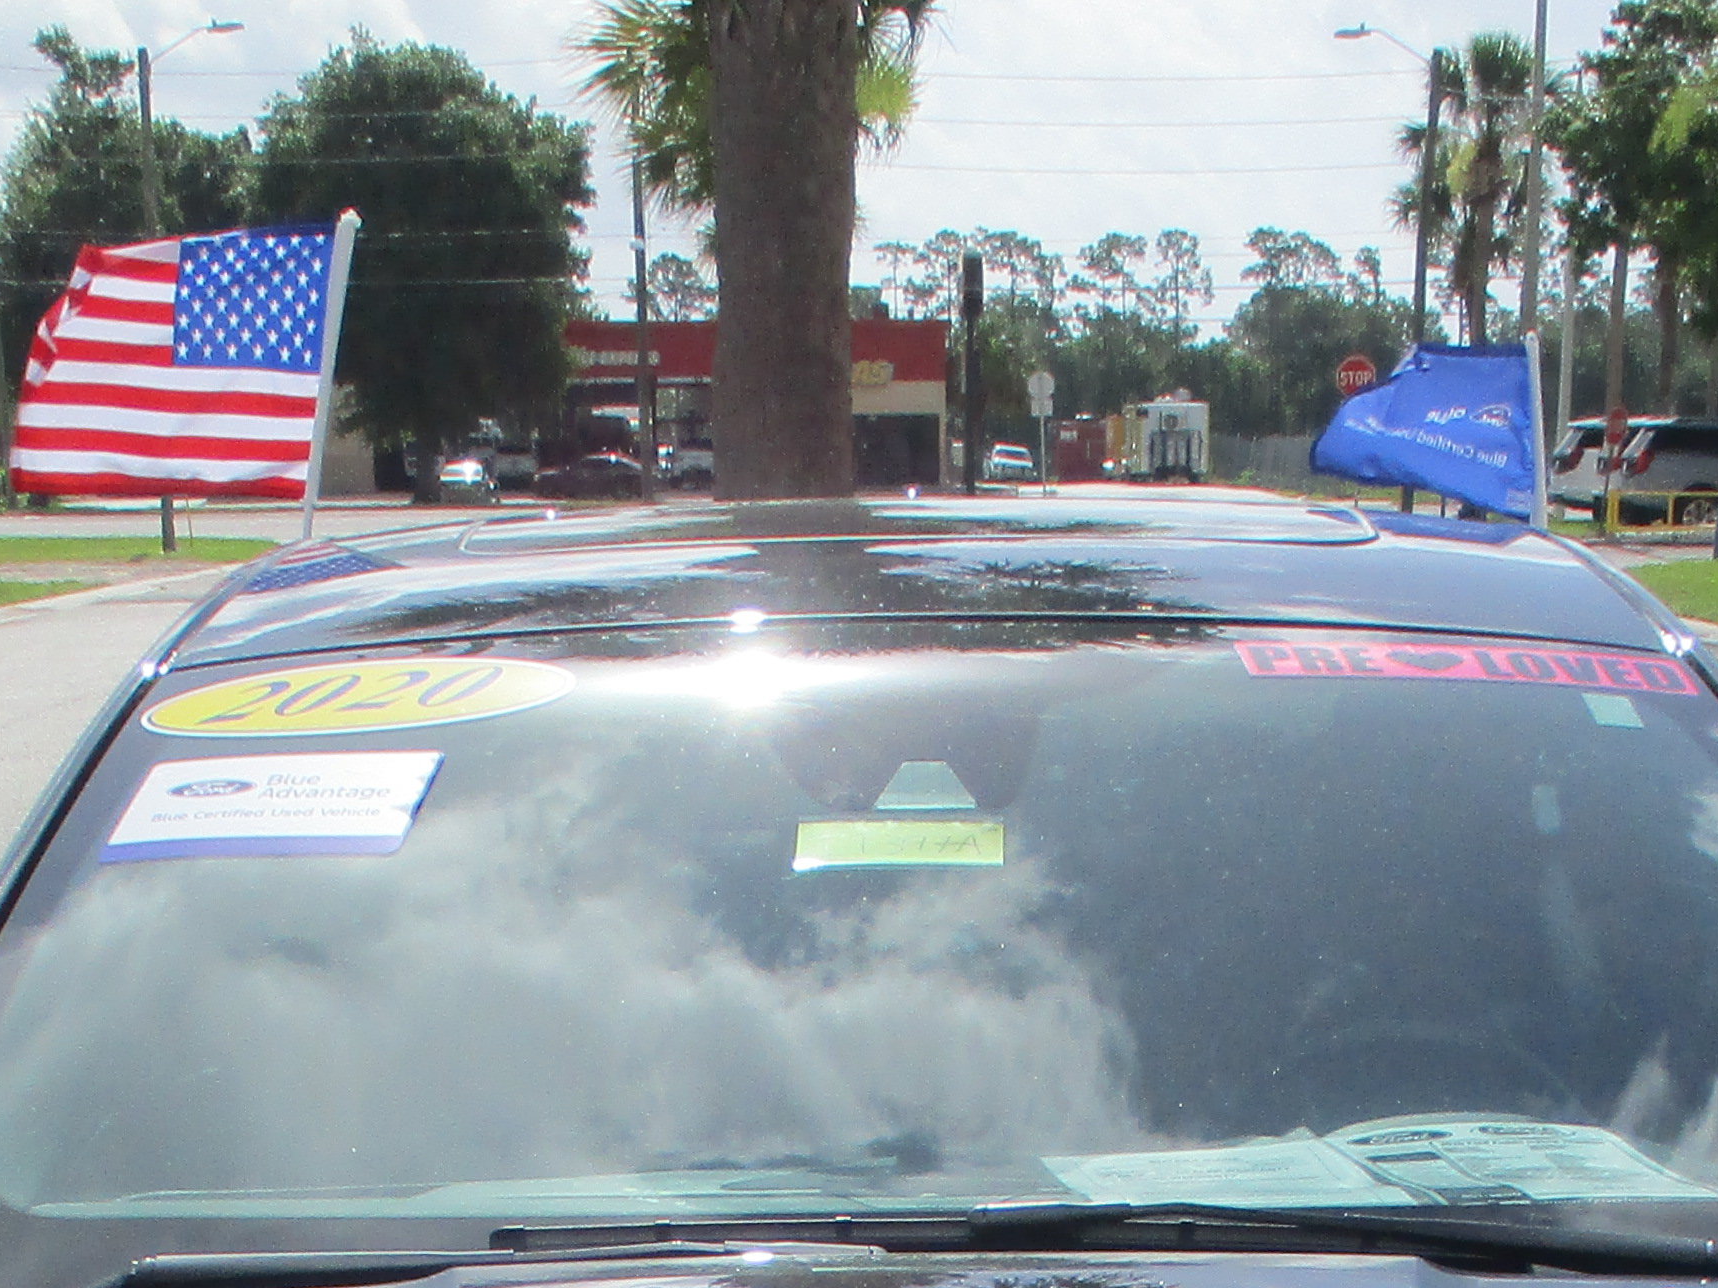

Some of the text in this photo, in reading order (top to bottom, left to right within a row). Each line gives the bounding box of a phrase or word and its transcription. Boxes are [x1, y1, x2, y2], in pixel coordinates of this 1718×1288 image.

[1339, 370, 1373, 387] STOP
[1248, 644, 1689, 690] PRE LOVED
[196, 665, 504, 726] 2020
[266, 773, 321, 786] Blue
[257, 786, 391, 800] Advantage
[151, 805, 381, 823] Blue Certified Used Vehicle
